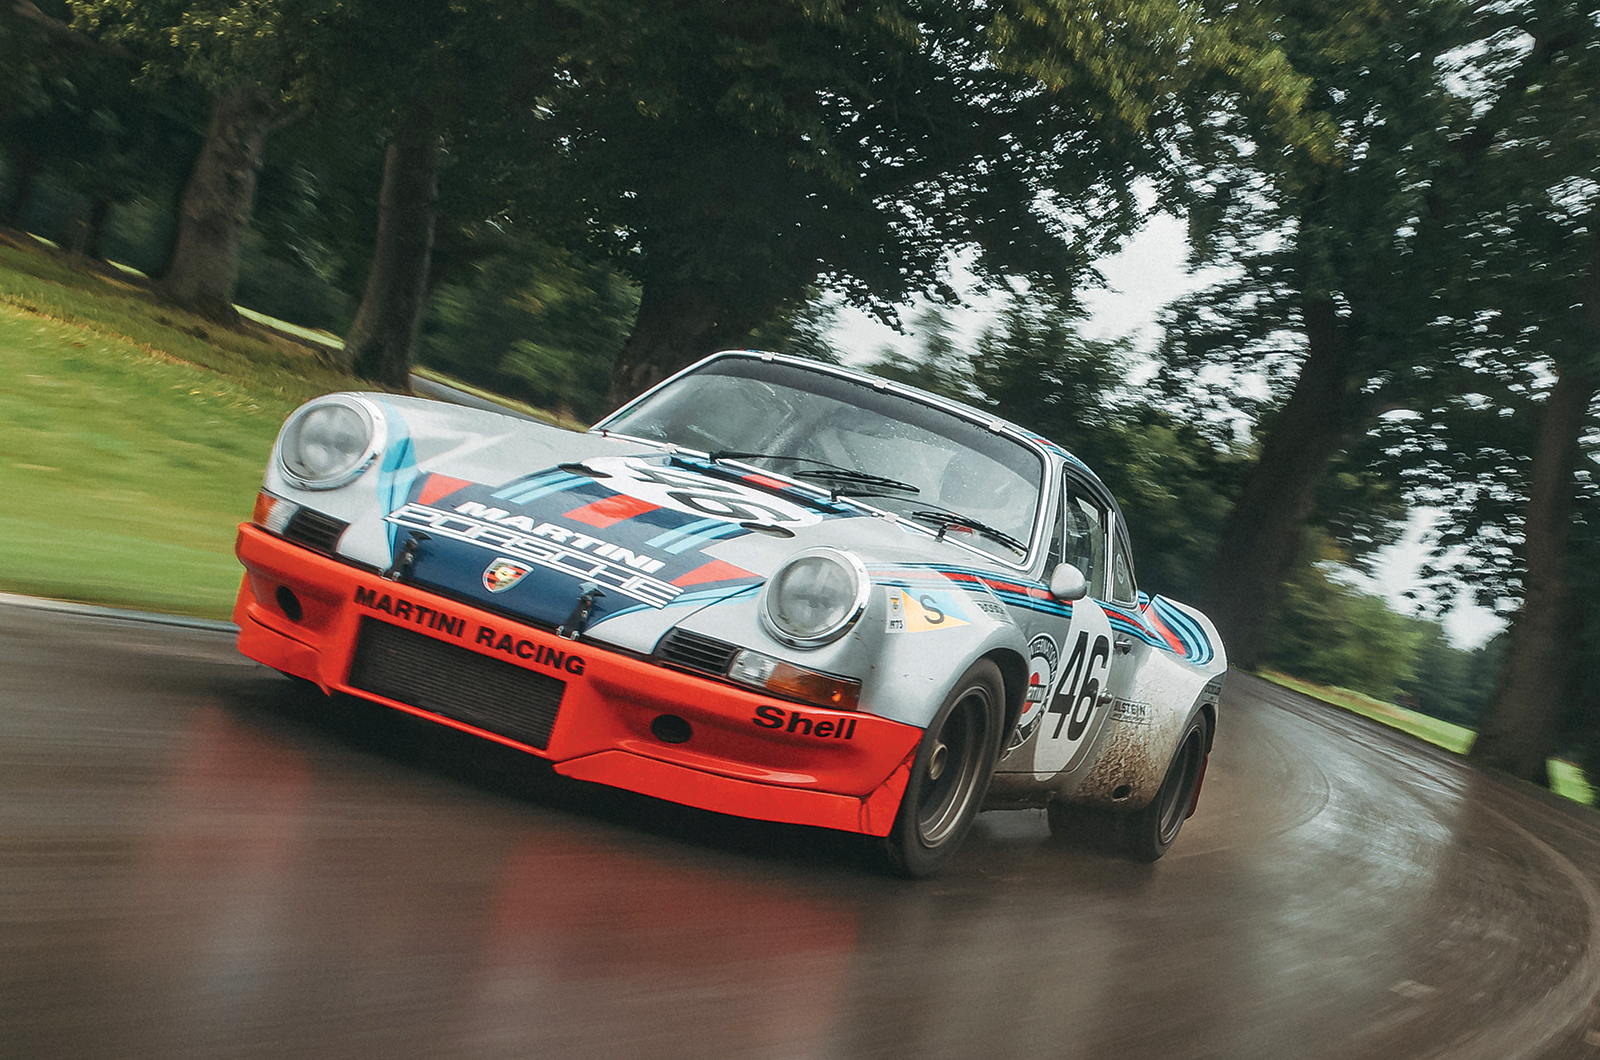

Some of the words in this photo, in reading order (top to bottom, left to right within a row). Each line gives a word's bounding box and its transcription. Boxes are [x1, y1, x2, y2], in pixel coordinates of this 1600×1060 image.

[383, 502, 684, 609] PORSCHE
[453, 501, 666, 573] MARTINI
[354, 586, 466, 638] MARTINI
[475, 625, 587, 677] RACING
[919, 594, 945, 625] S
[751, 705, 857, 740] Shell
[1048, 630, 1110, 741] 46
